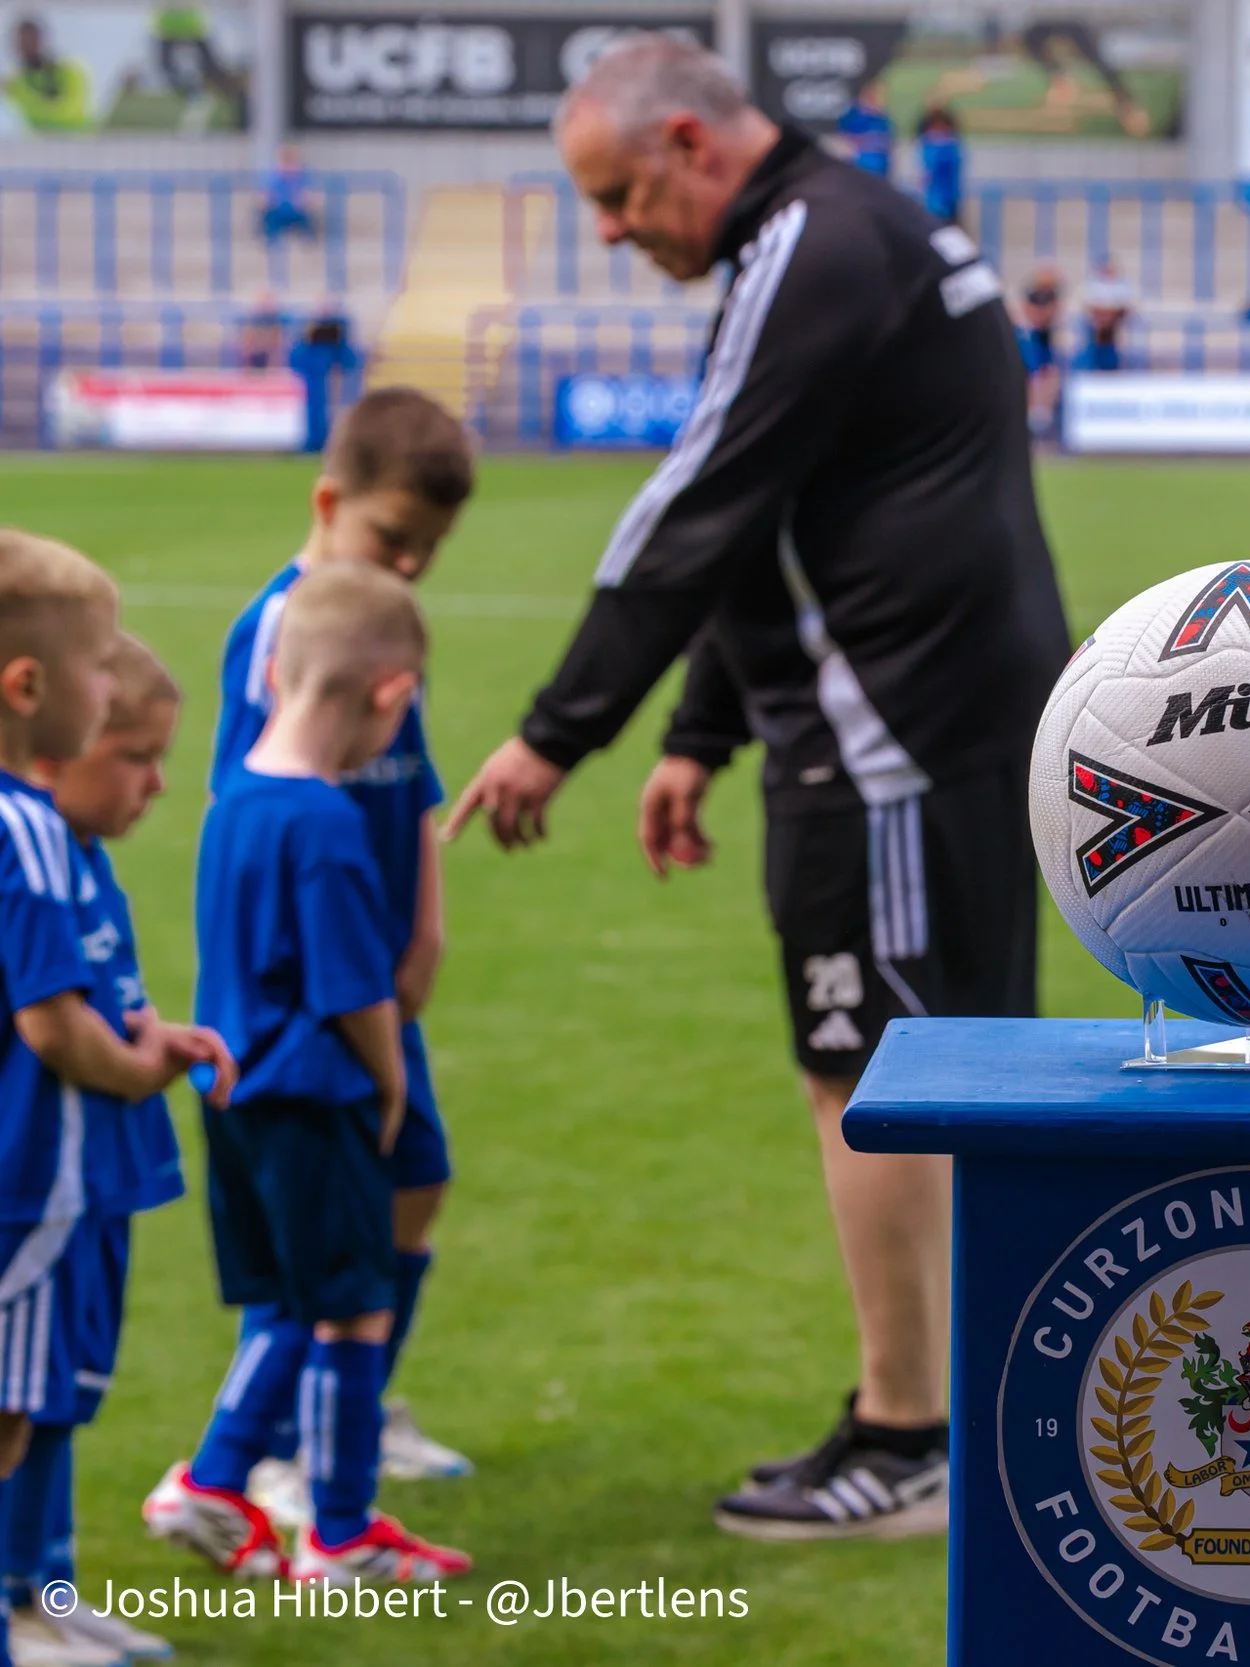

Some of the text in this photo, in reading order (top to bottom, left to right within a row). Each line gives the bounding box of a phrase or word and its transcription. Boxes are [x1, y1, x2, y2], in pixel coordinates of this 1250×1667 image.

[305, 24, 515, 94] UCFB
[1033, 1186, 1244, 1360] CURZON
[1035, 1417, 1058, 1439] 19
[1184, 1460, 1227, 1486] LABOR
